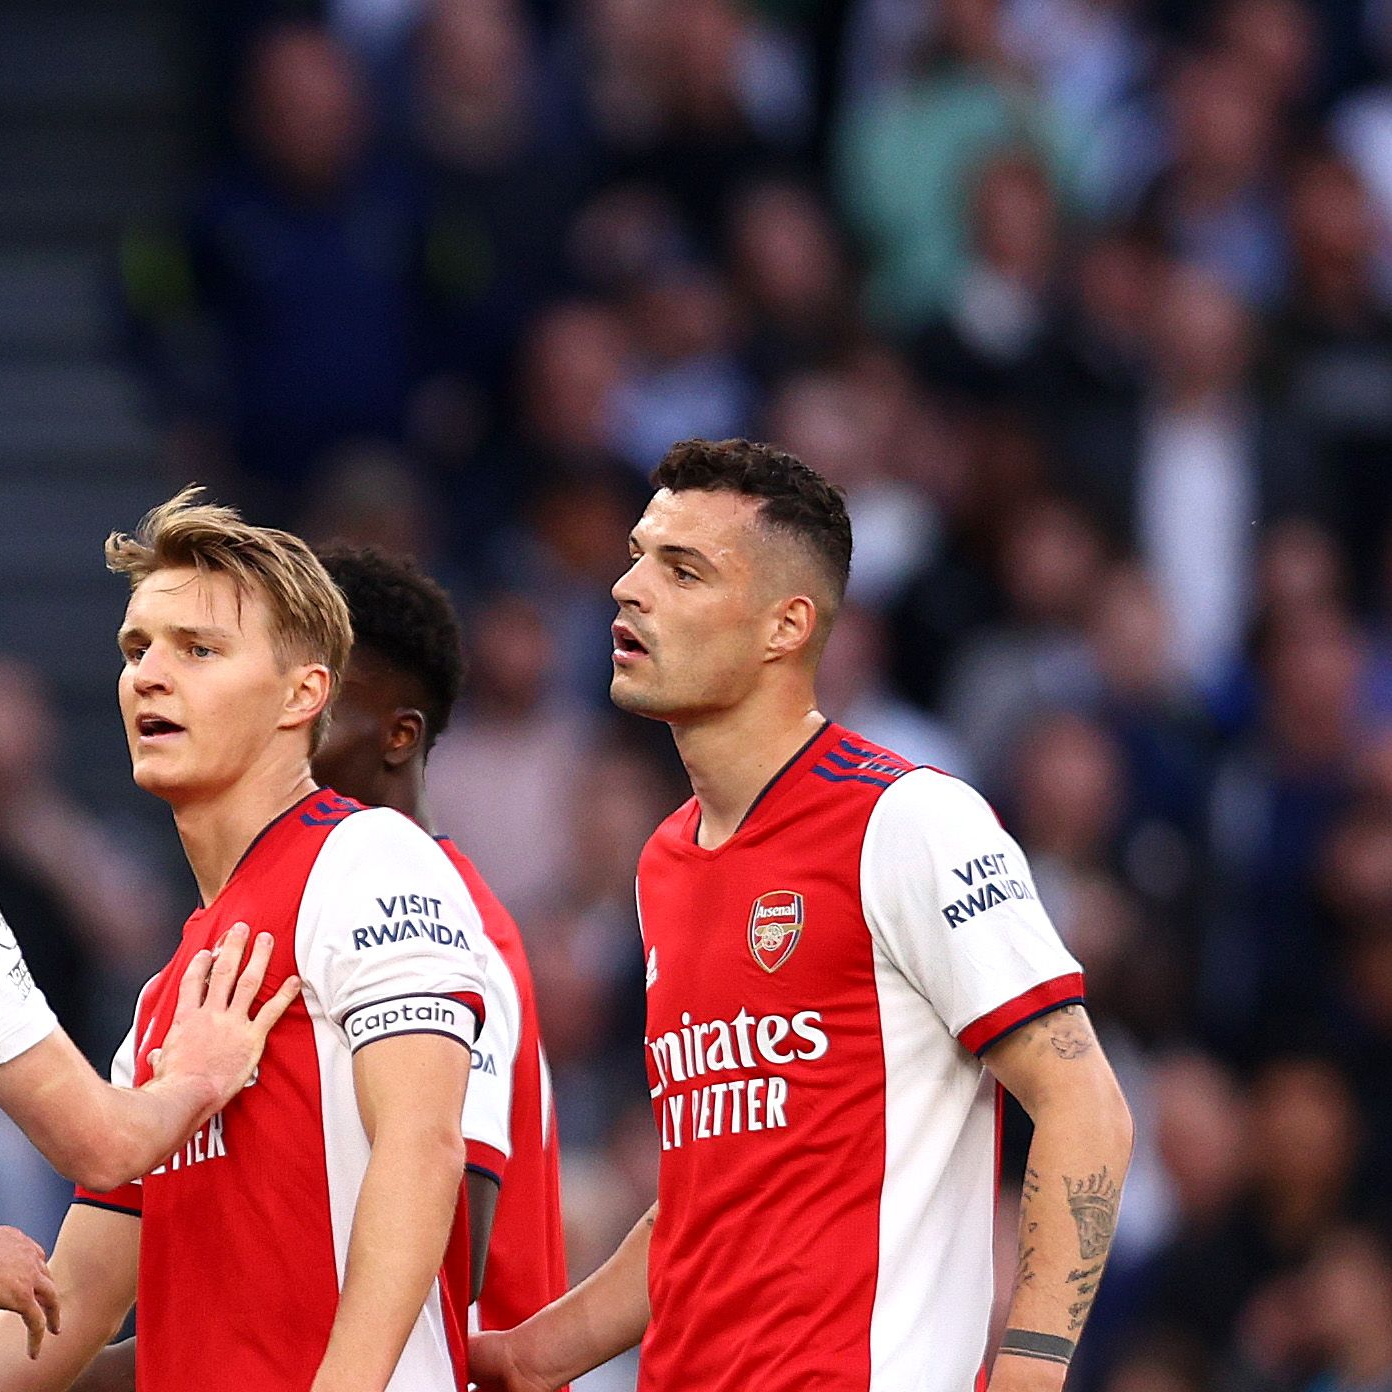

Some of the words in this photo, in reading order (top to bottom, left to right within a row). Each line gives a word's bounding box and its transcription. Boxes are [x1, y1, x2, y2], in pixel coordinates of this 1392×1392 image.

[951, 853, 1008, 886] VISIT
[376, 894, 442, 919] VISIT
[757, 902, 795, 918] Arsenal
[352, 919, 471, 950] RWANDA
[351, 1002, 455, 1037] Captain
